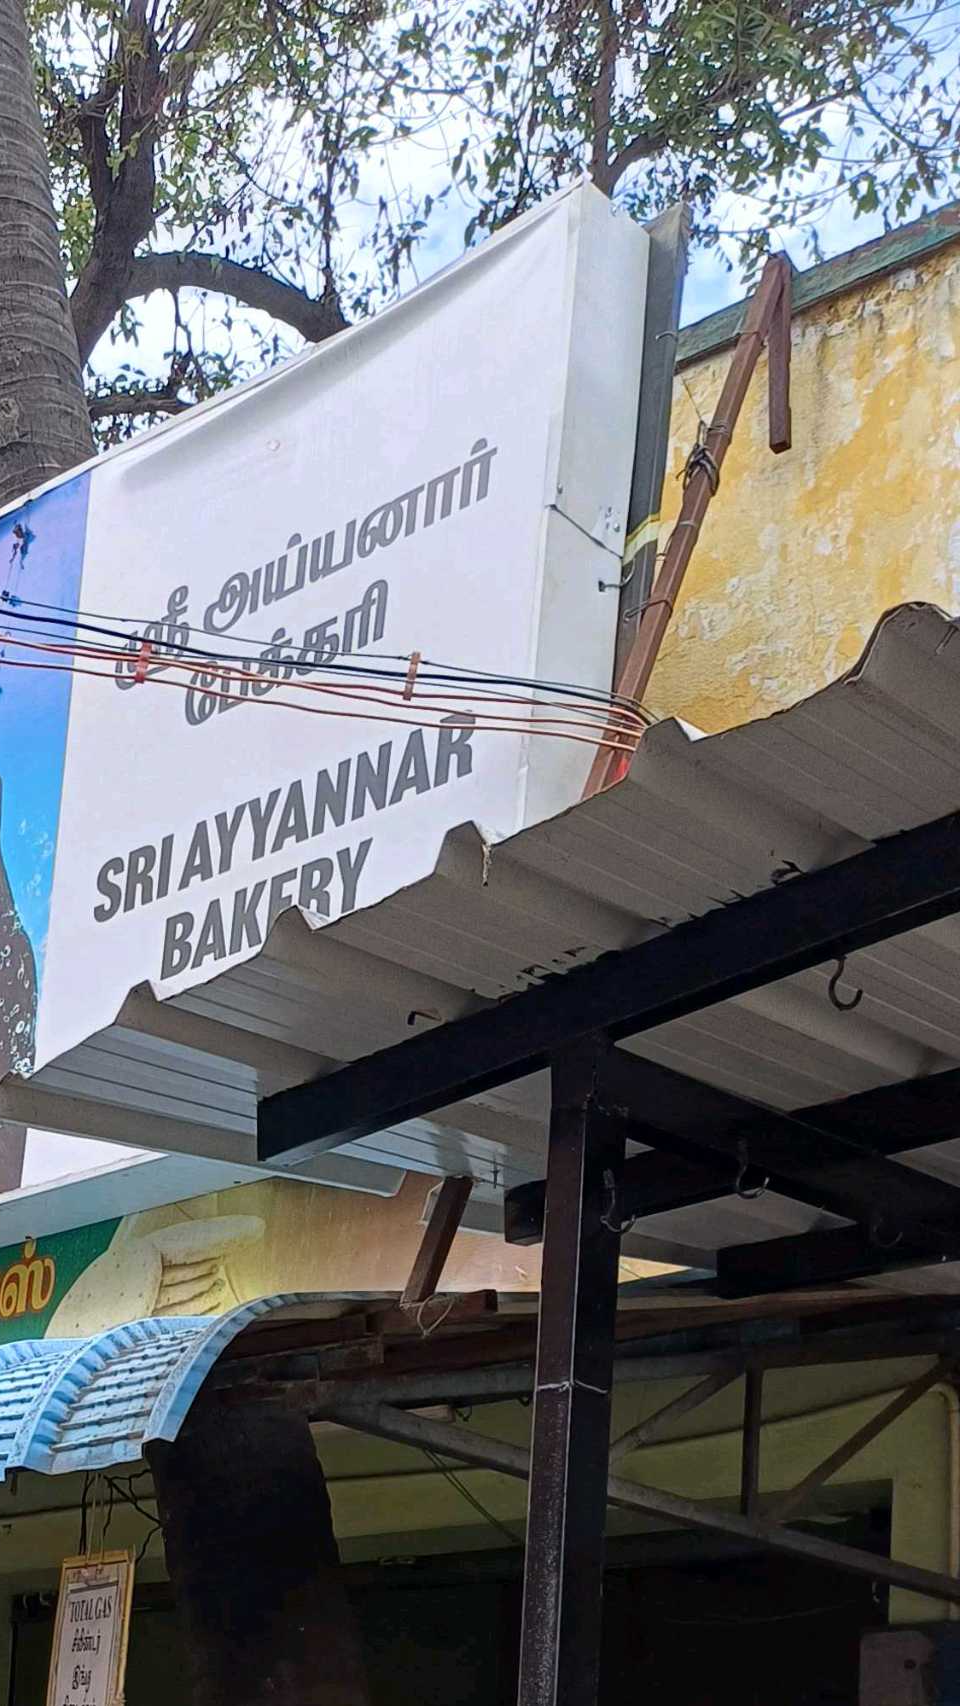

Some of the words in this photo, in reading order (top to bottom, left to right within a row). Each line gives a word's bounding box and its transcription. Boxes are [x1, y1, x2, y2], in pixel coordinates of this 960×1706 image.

[203, 438, 498, 634] அய்யனார்
[184, 578, 390, 726] பேக்கரி
[93, 832, 175, 923] SRI
[178, 709, 477, 891] AYYANNAR
[160, 837, 374, 981] BAKERY
[69, 1598, 94, 1623] TOTAL
[94, 1595, 113, 1620] GAS
